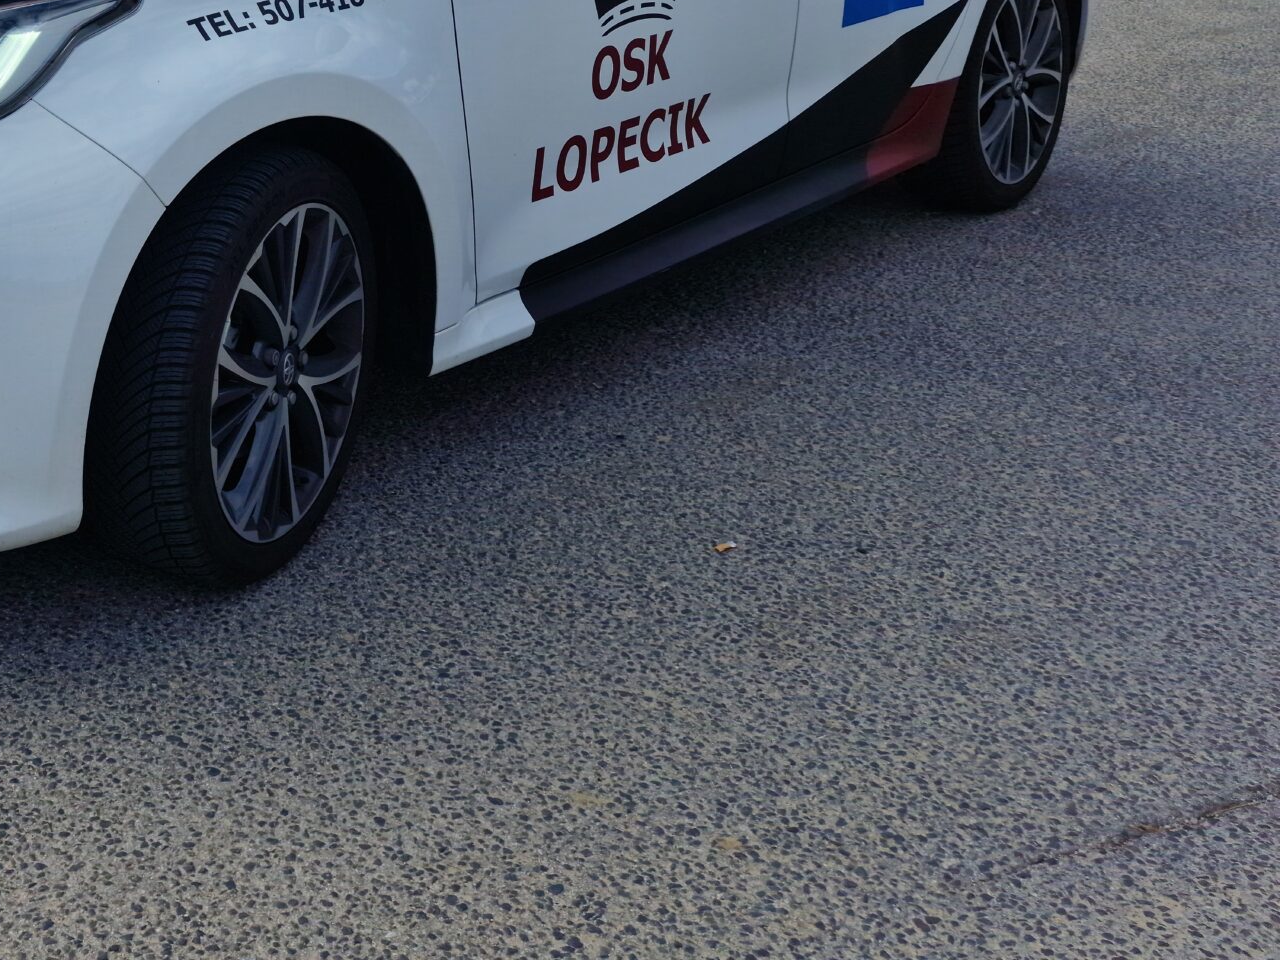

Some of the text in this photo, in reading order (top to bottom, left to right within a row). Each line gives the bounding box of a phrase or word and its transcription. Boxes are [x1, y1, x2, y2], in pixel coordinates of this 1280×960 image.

[186, 9, 257, 41] TEL:
[591, 29, 673, 101] OSK
[531, 92, 711, 202] LOPECIK
